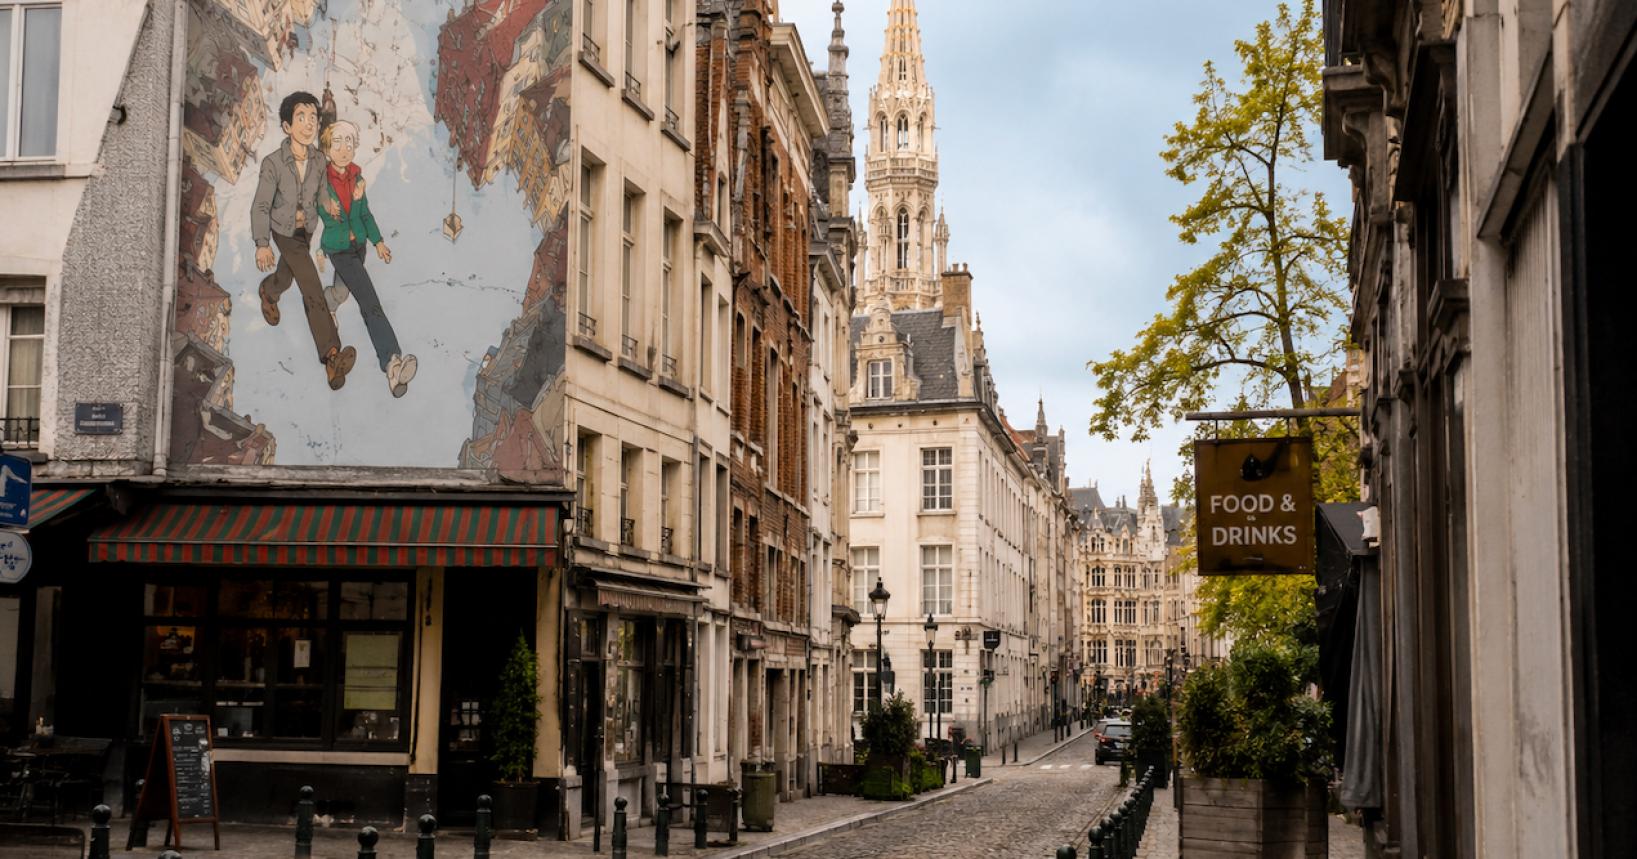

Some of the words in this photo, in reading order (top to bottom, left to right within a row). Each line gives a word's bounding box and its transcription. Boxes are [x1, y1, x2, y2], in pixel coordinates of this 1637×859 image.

[1210, 494, 1274, 514] FOOD
[1280, 493, 1296, 512] &
[1212, 525, 1297, 546] DRINKS
